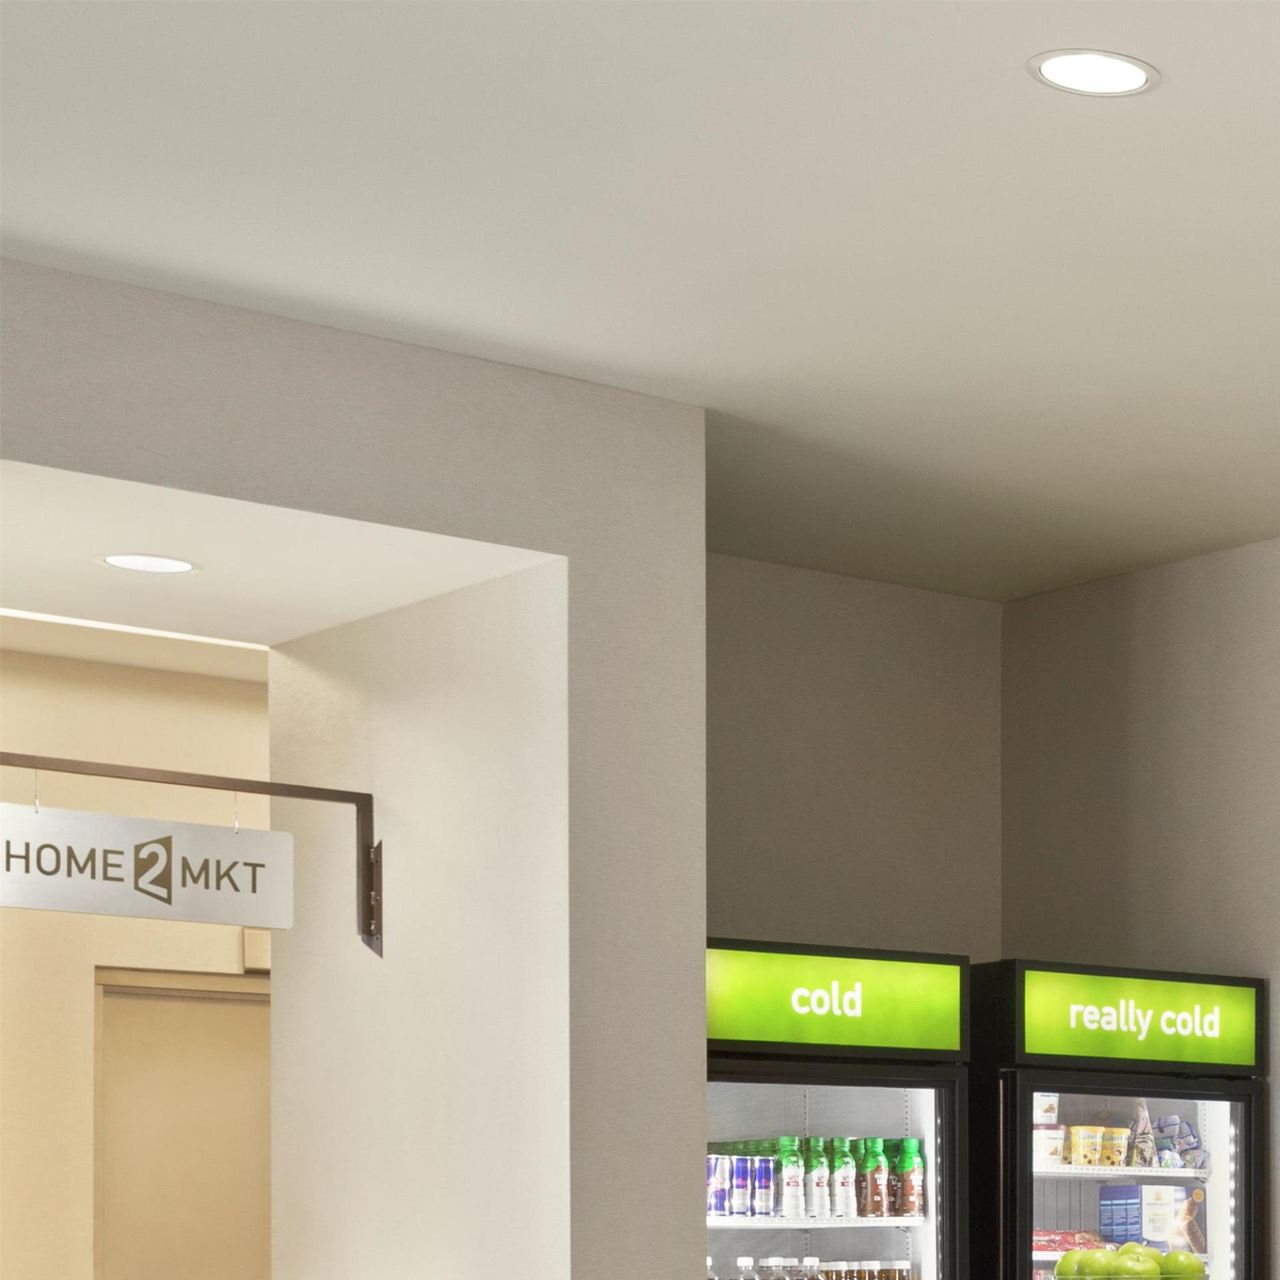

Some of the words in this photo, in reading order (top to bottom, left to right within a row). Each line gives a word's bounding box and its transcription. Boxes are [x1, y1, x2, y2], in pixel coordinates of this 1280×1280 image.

[5, 840, 125, 882] HOME
[181, 856, 266, 894] MKT
[791, 981, 862, 1018] cold
[1069, 1000, 1153, 1041] really
[1161, 1006, 1220, 1039] cold
